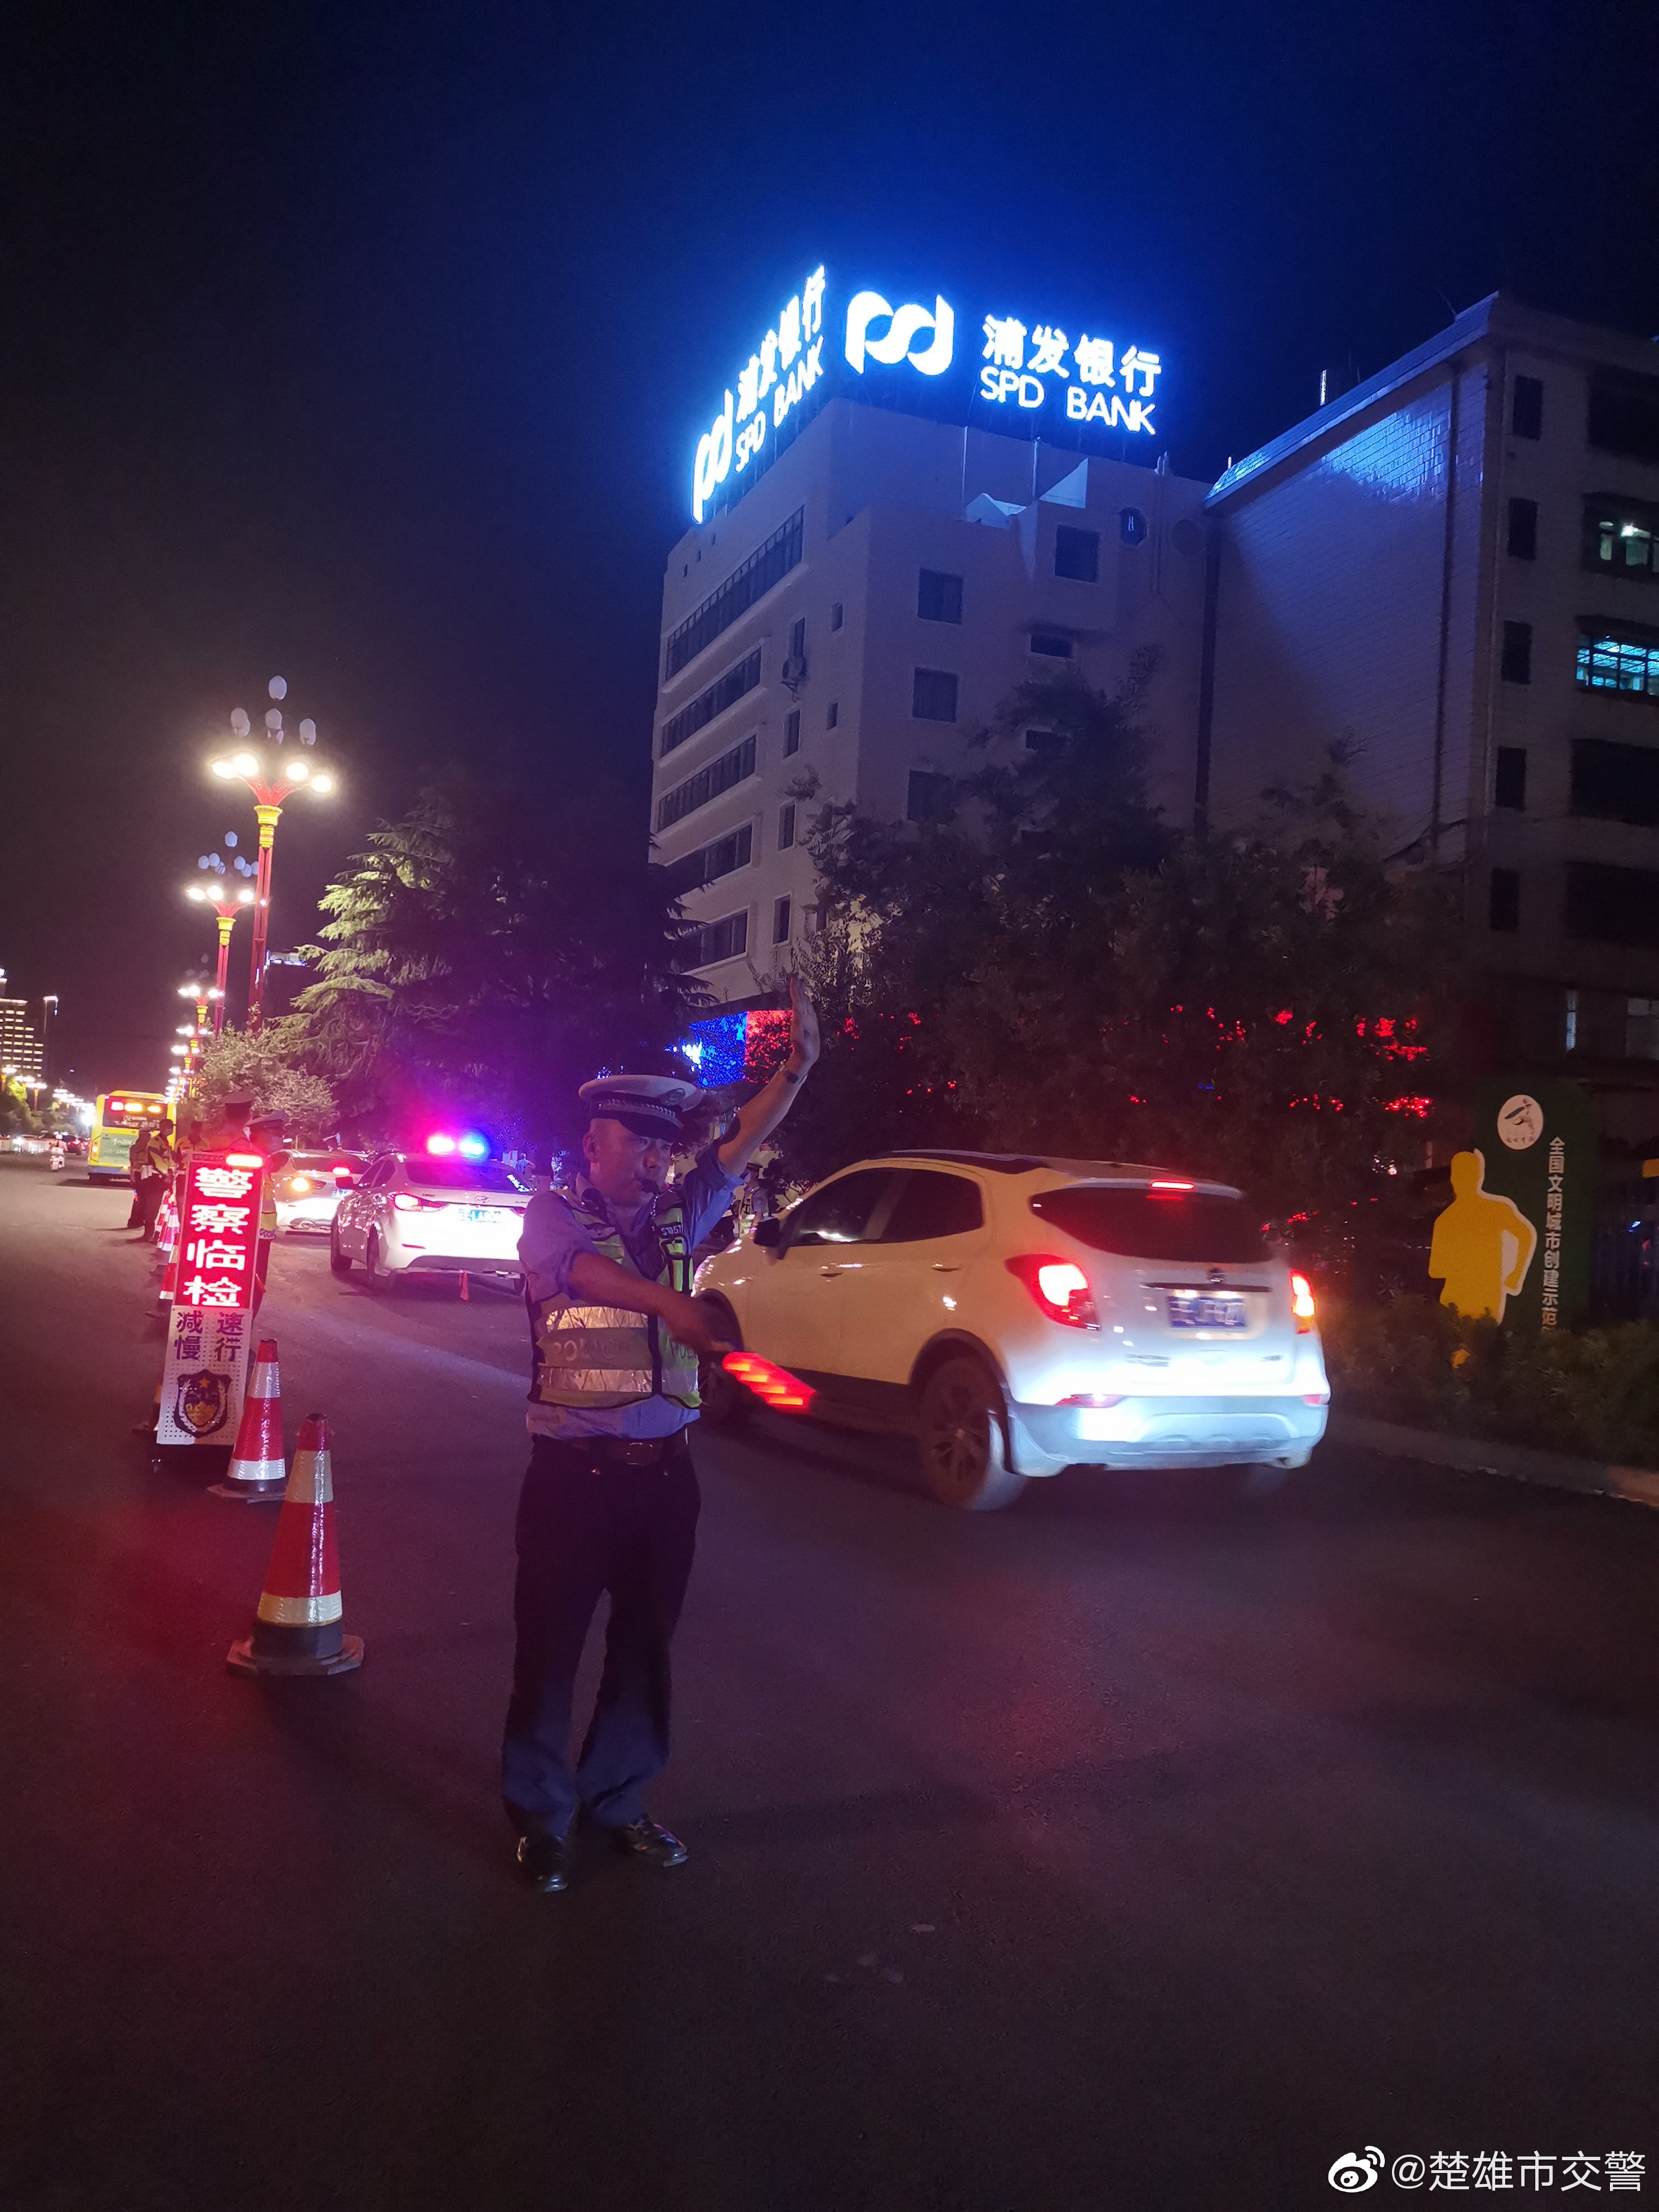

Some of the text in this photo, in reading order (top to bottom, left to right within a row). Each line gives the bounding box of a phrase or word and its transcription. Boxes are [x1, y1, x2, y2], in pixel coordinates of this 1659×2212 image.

[735, 334, 824, 473] SPD BANK
[979, 365, 1156, 435] SPD BANK
[982, 314, 1162, 397] 浦发银行
[182, 1166, 254, 1307] 警察临检
[1541, 1136, 1565, 1333] 全国文明城市创建示范
[174, 1335, 241, 1362] 慢行
